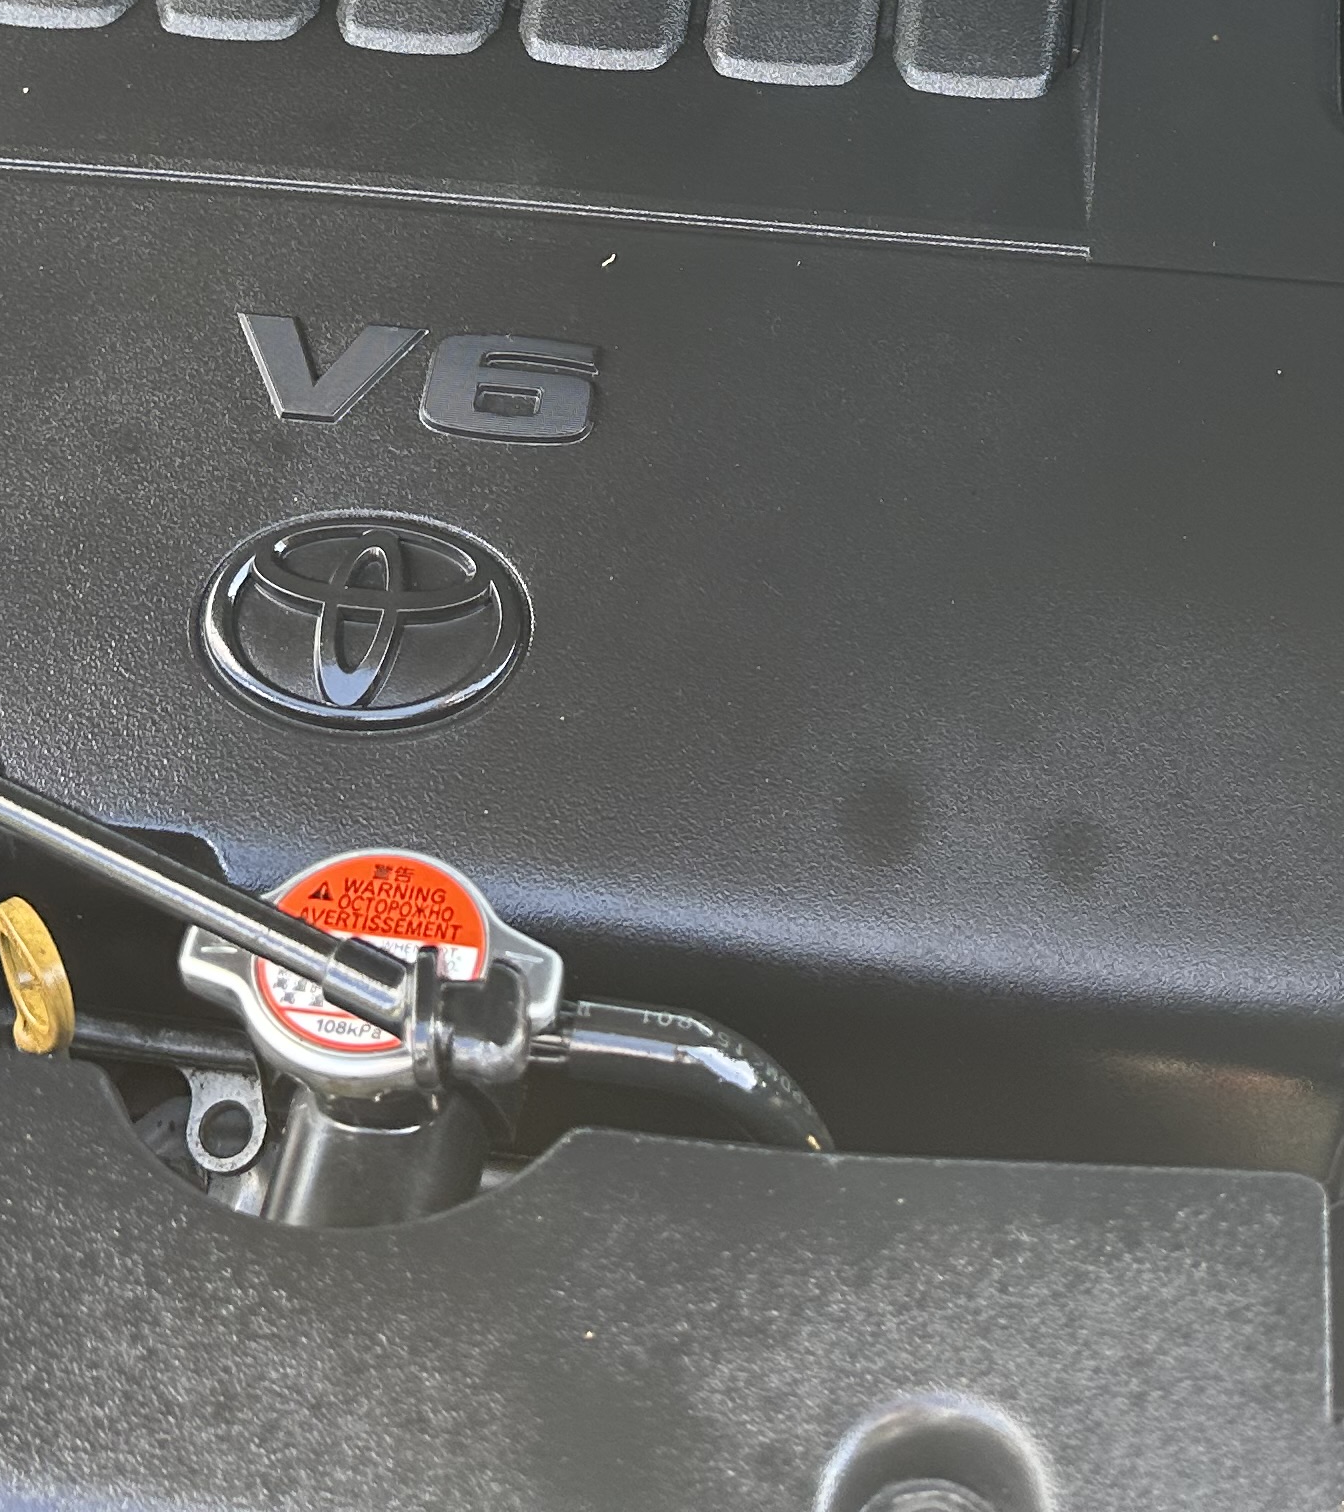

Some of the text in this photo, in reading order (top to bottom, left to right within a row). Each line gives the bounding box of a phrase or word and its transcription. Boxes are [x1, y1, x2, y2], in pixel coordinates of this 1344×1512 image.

[236, 311, 601, 447] V6
[372, 863, 415, 884] 警告
[344, 877, 448, 905] WARNING
[337, 893, 455, 923] ОСТОРОЖНО
[300, 906, 463, 942] AVERTISSEMENT
[315, 1017, 383, 1041] 108kPa
